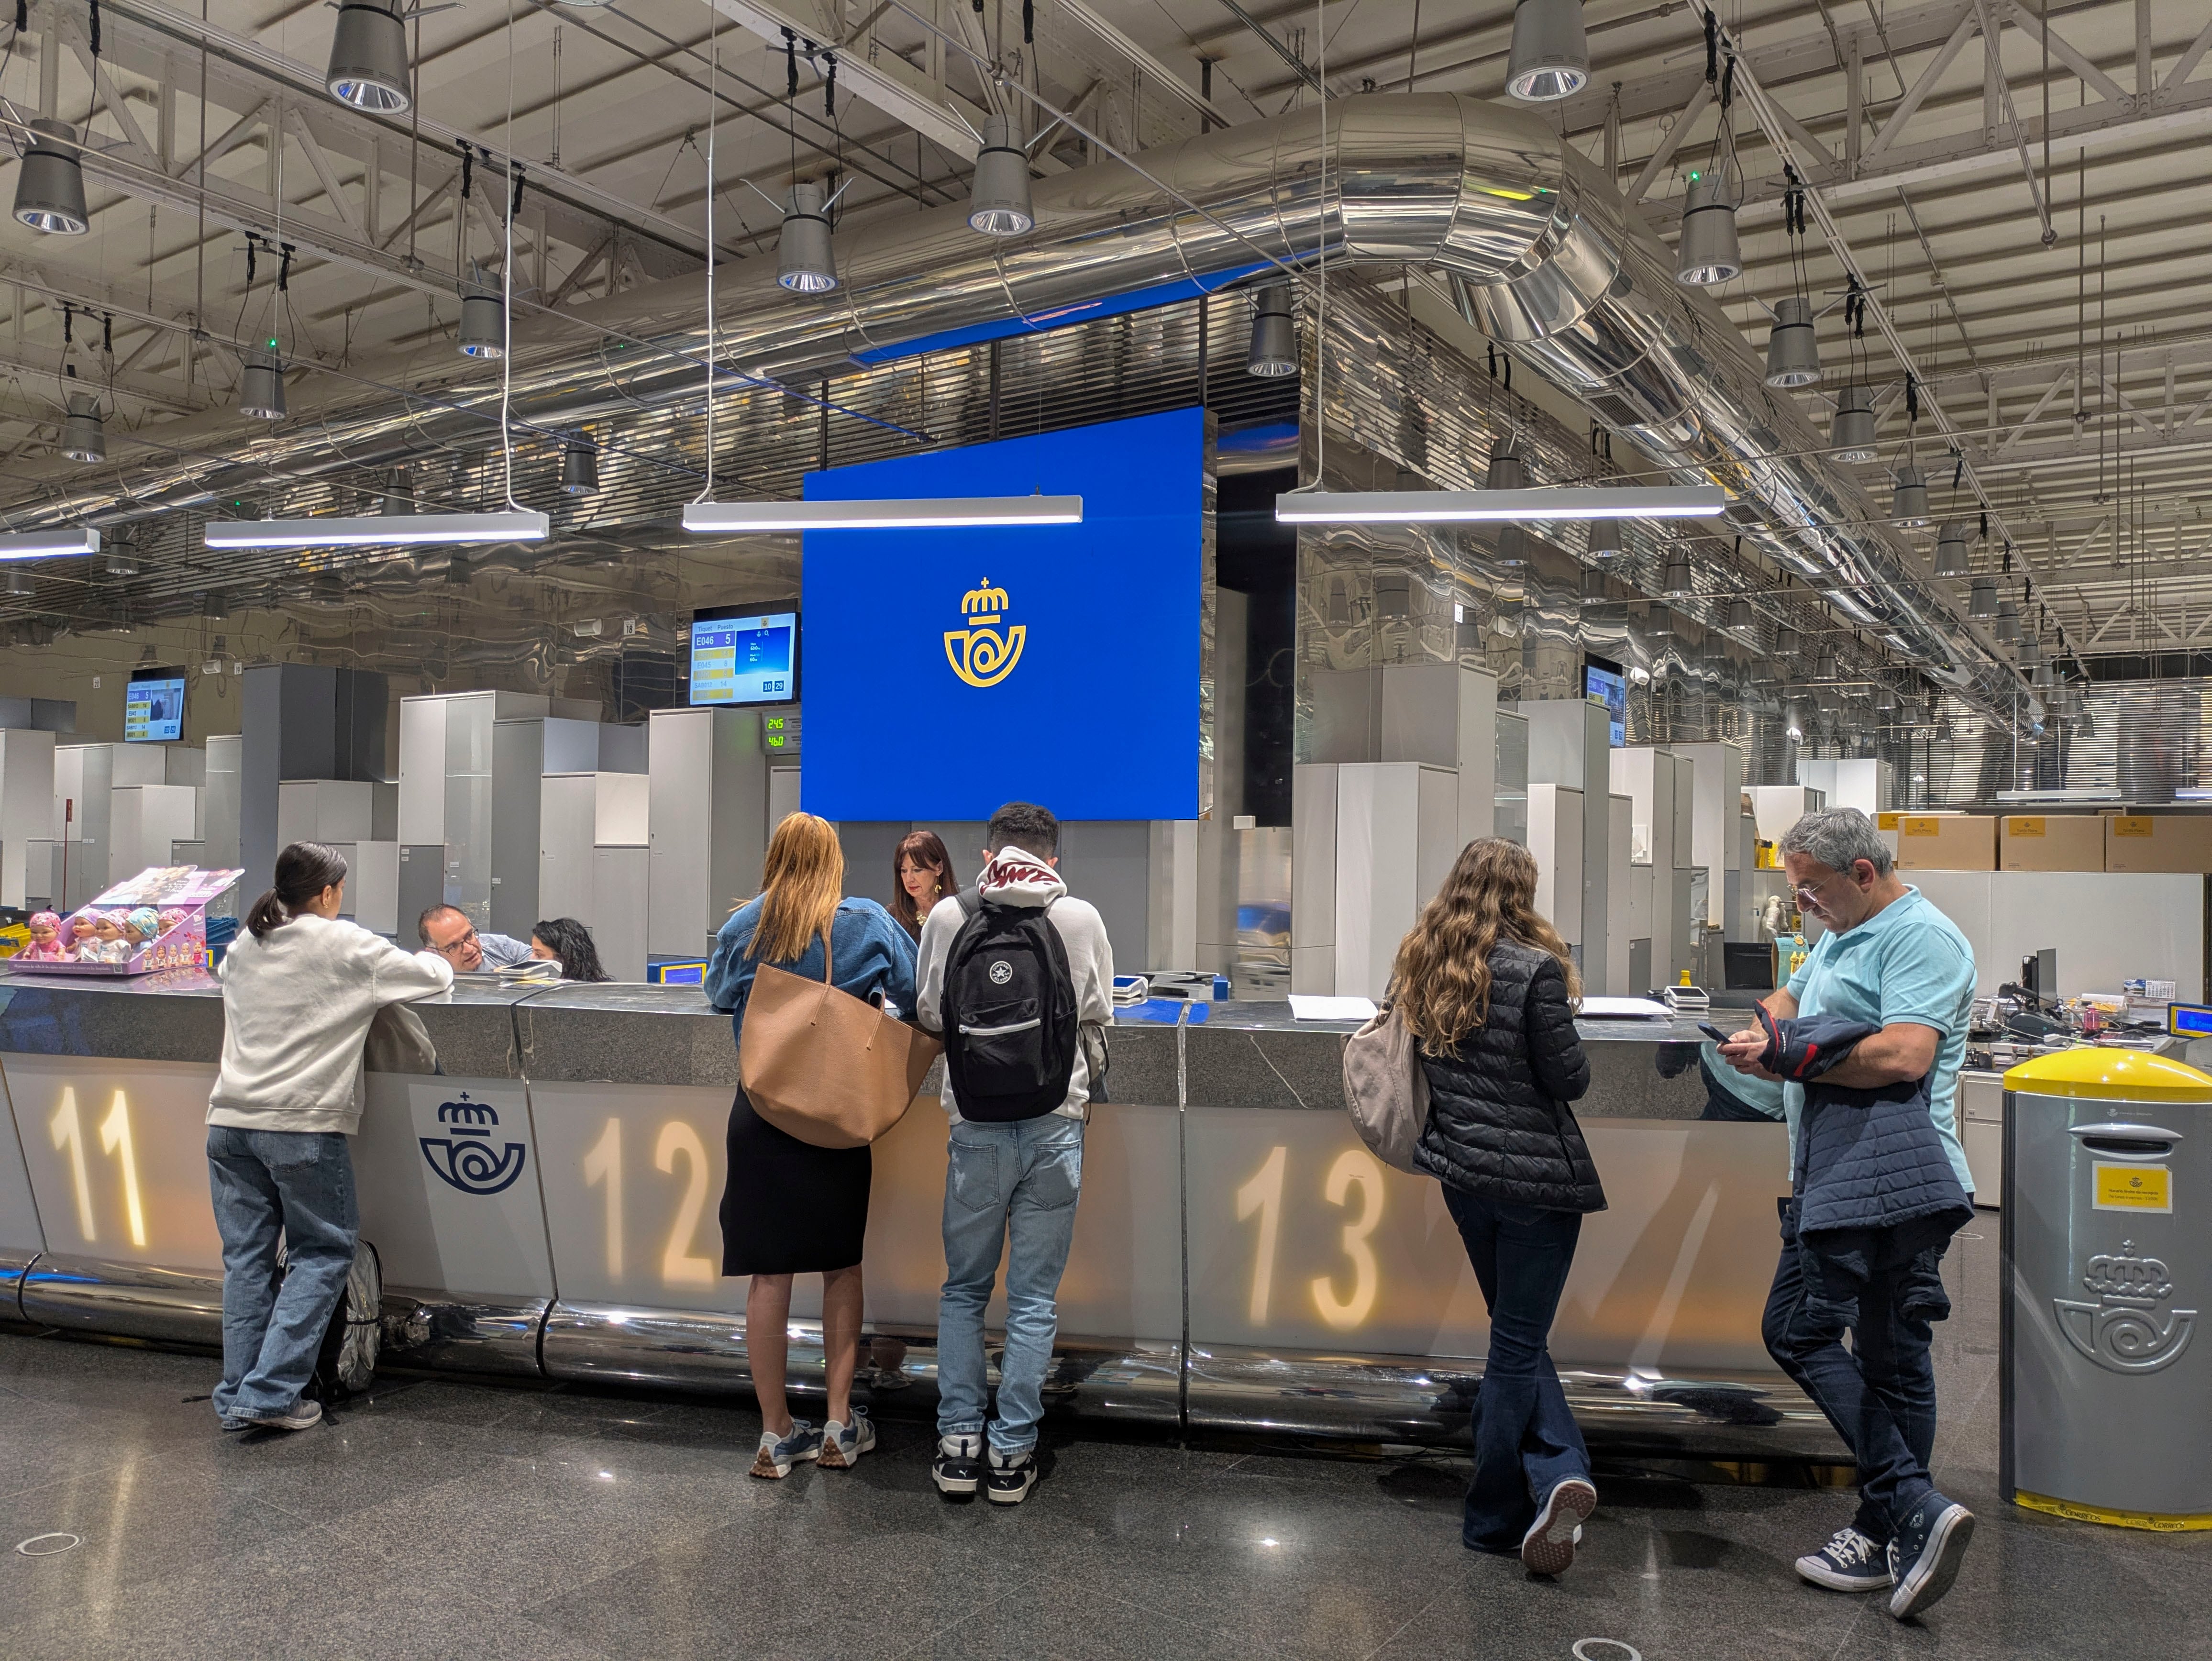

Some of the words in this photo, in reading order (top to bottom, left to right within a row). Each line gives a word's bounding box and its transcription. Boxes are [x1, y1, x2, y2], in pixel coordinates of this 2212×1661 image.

[697, 636, 714, 646] E046
[725, 634, 730, 644] 5
[145, 691, 149, 699] 5
[51, 1086, 146, 1246] 11
[584, 1118, 716, 1290] 12
[1237, 1146, 1384, 1329] 13
[2065, 1509, 2101, 1521] CORREOS
[2154, 1521, 2185, 1529] CORREOS
